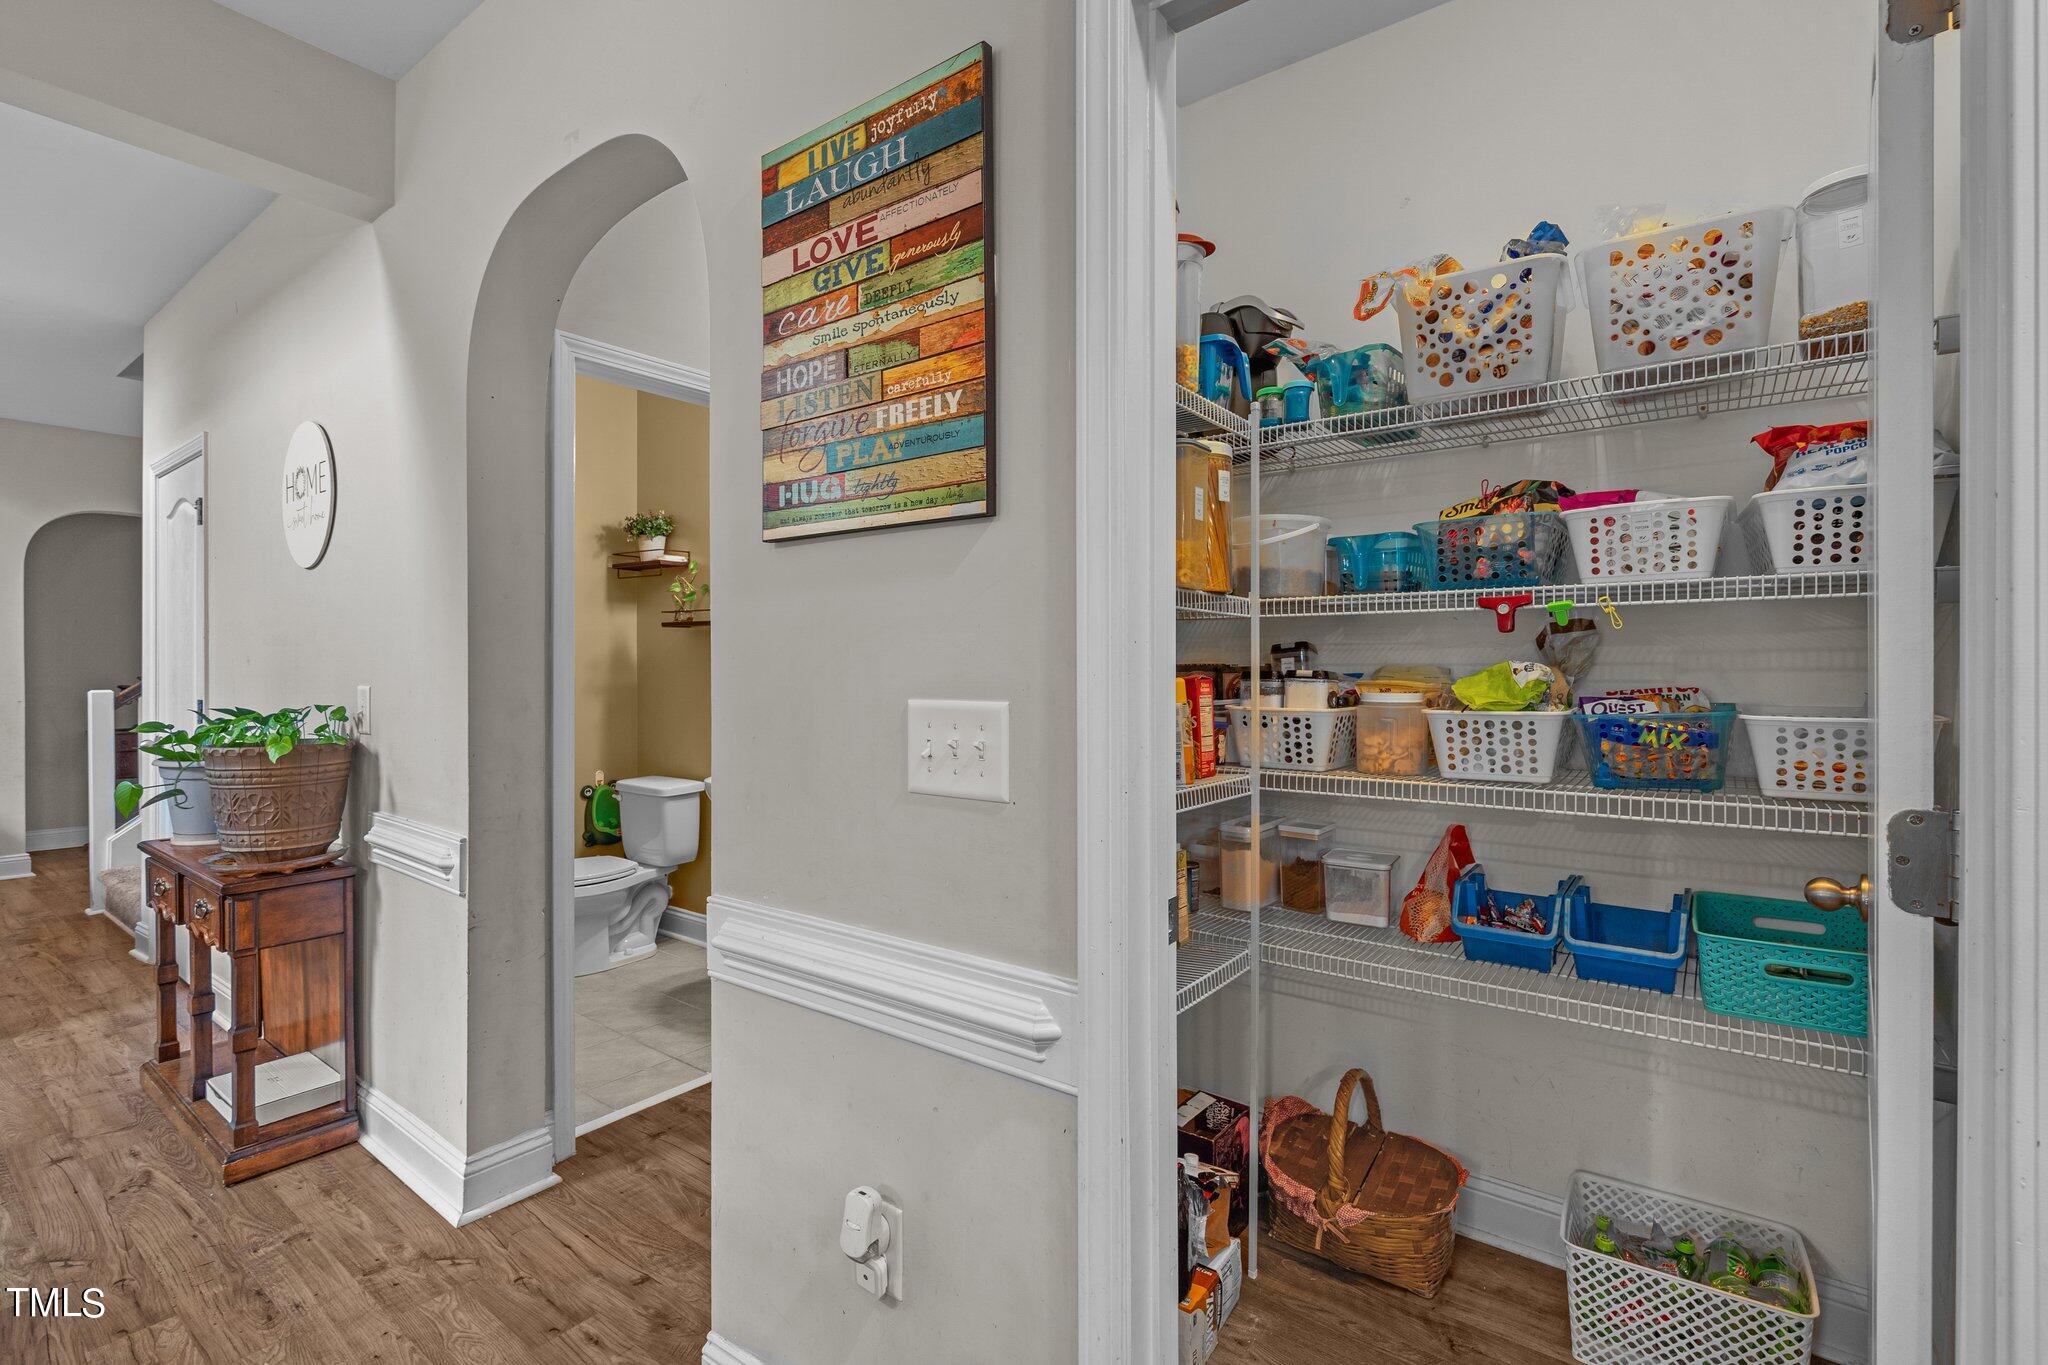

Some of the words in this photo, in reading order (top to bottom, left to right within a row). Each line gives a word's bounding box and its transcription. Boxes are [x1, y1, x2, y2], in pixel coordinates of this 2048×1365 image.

[807, 127, 860, 170] LIVE
[870, 90, 939, 142] joyfully
[784, 136, 908, 215] LAUGH
[843, 152, 935, 208] abundantly
[792, 213, 878, 273] LOVE
[880, 182, 960, 223] AFFECTIONATELY
[812, 246, 884, 292] GIVE
[889, 221, 961, 275] generously
[864, 277, 914, 305] DEEPLY
[778, 295, 850, 336] care
[812, 326, 848, 346] smile
[852, 291, 959, 337] spontaneously
[776, 355, 836, 394] HOPE
[853, 350, 913, 374] ETERNALLY
[777, 376, 876, 423] LISTEN
[887, 371, 952, 395] carefully
[780, 410, 871, 472] forgive
[876, 389, 964, 428] FREELY
[836, 433, 905, 468] PLAY
[888, 430, 960, 451] ADVENTUROUSLY
[1825, 441, 1867, 455] POPCO
[285, 460, 326, 503] HOME
[779, 477, 842, 507] HUG
[853, 470, 899, 502] tightly
[844, 507, 859, 516] that
[861, 502, 892, 514] tomorrow
[894, 501, 902, 509] is
[910, 498, 923, 508] new
[926, 495, 939, 506] day
[1591, 703, 1646, 715] QUEST
